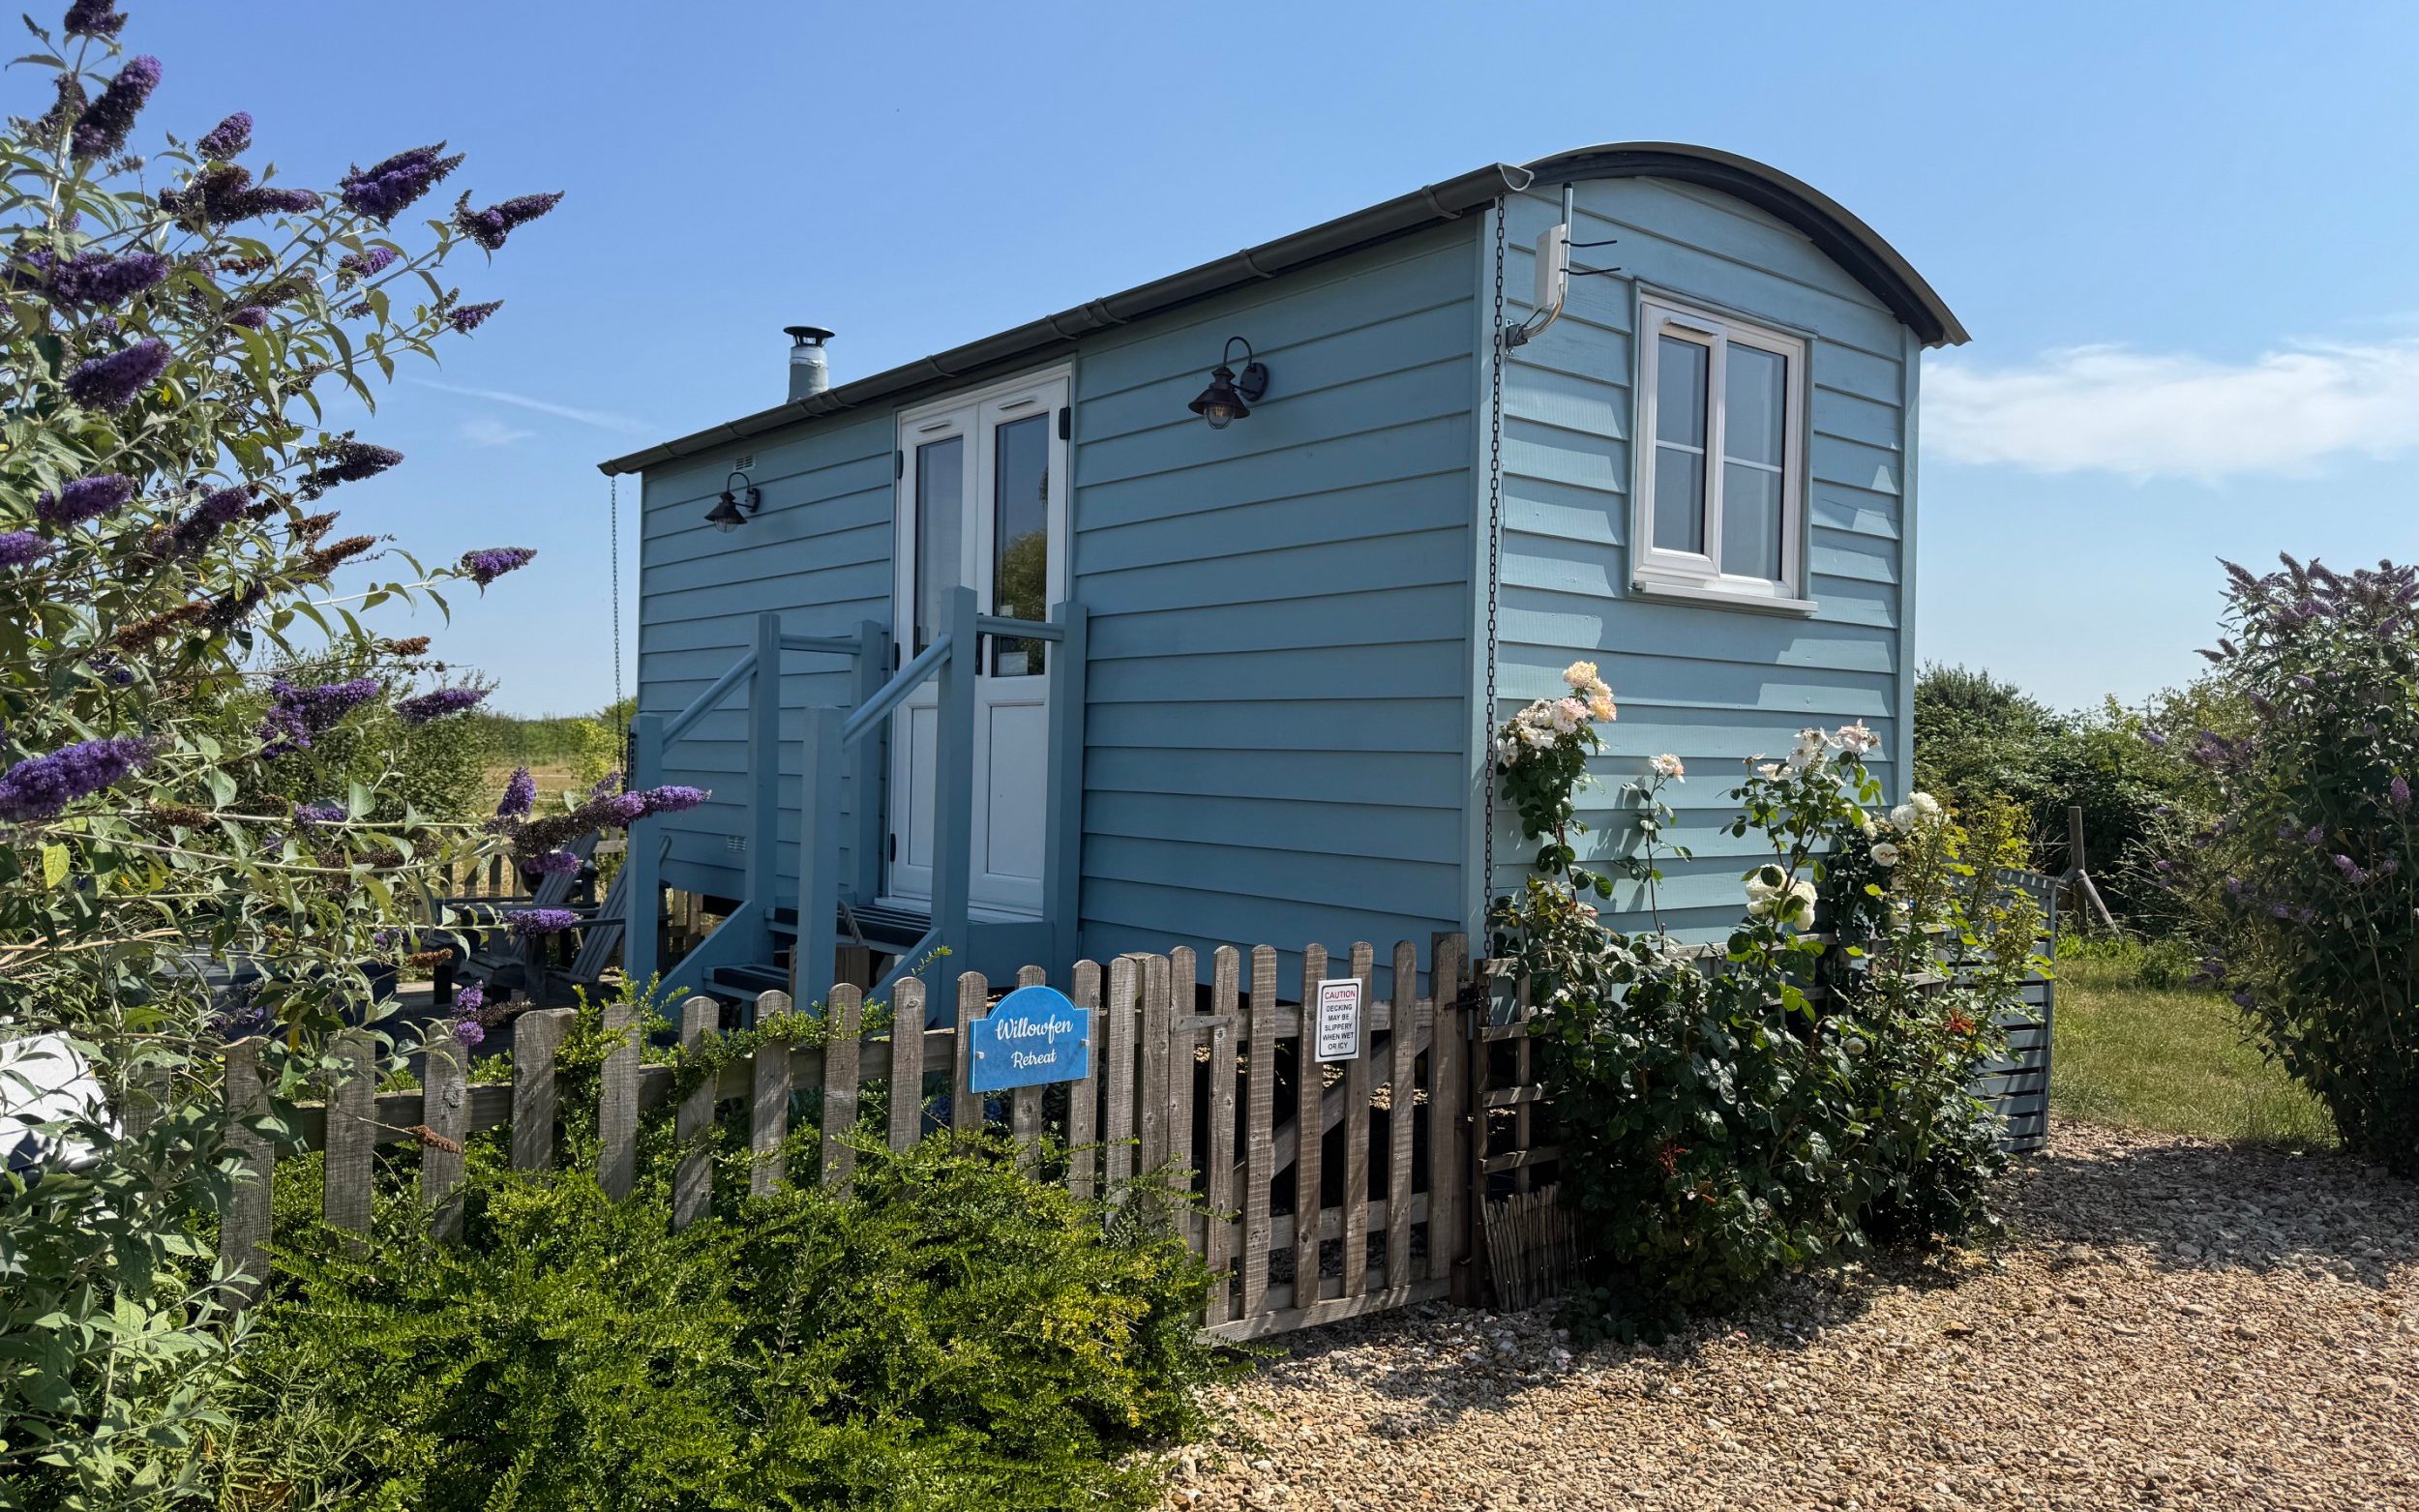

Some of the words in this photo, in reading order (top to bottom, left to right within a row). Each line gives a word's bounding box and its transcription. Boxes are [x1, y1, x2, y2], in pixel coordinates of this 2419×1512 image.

[1325, 991, 1356, 999] CAUTION
[1327, 1004, 1353, 1013] DECKING
[996, 1014, 1073, 1044] Willowfen
[1011, 1049, 1057, 1069] Retreat
